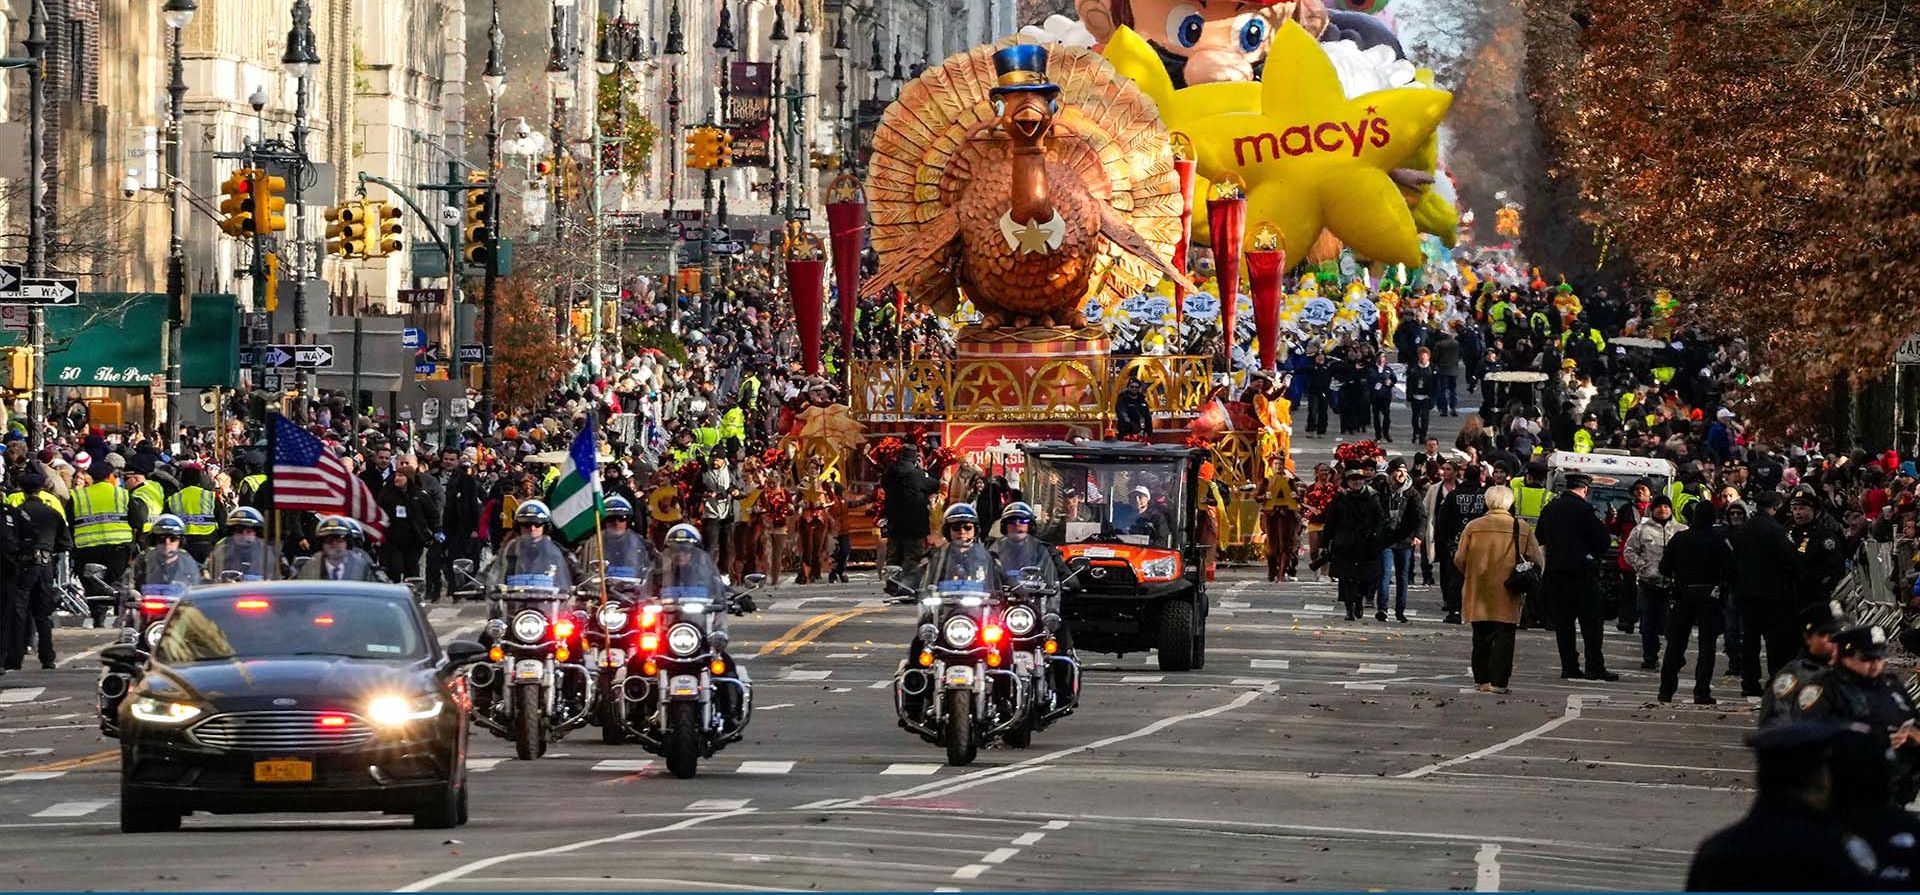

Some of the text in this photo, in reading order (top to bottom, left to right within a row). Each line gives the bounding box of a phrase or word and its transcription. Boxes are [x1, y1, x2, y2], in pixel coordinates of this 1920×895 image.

[41, 287, 65, 297] WAY
[303, 352, 324, 361] WAY
[60, 366, 82, 380] 50
[94, 366, 121, 382] The
